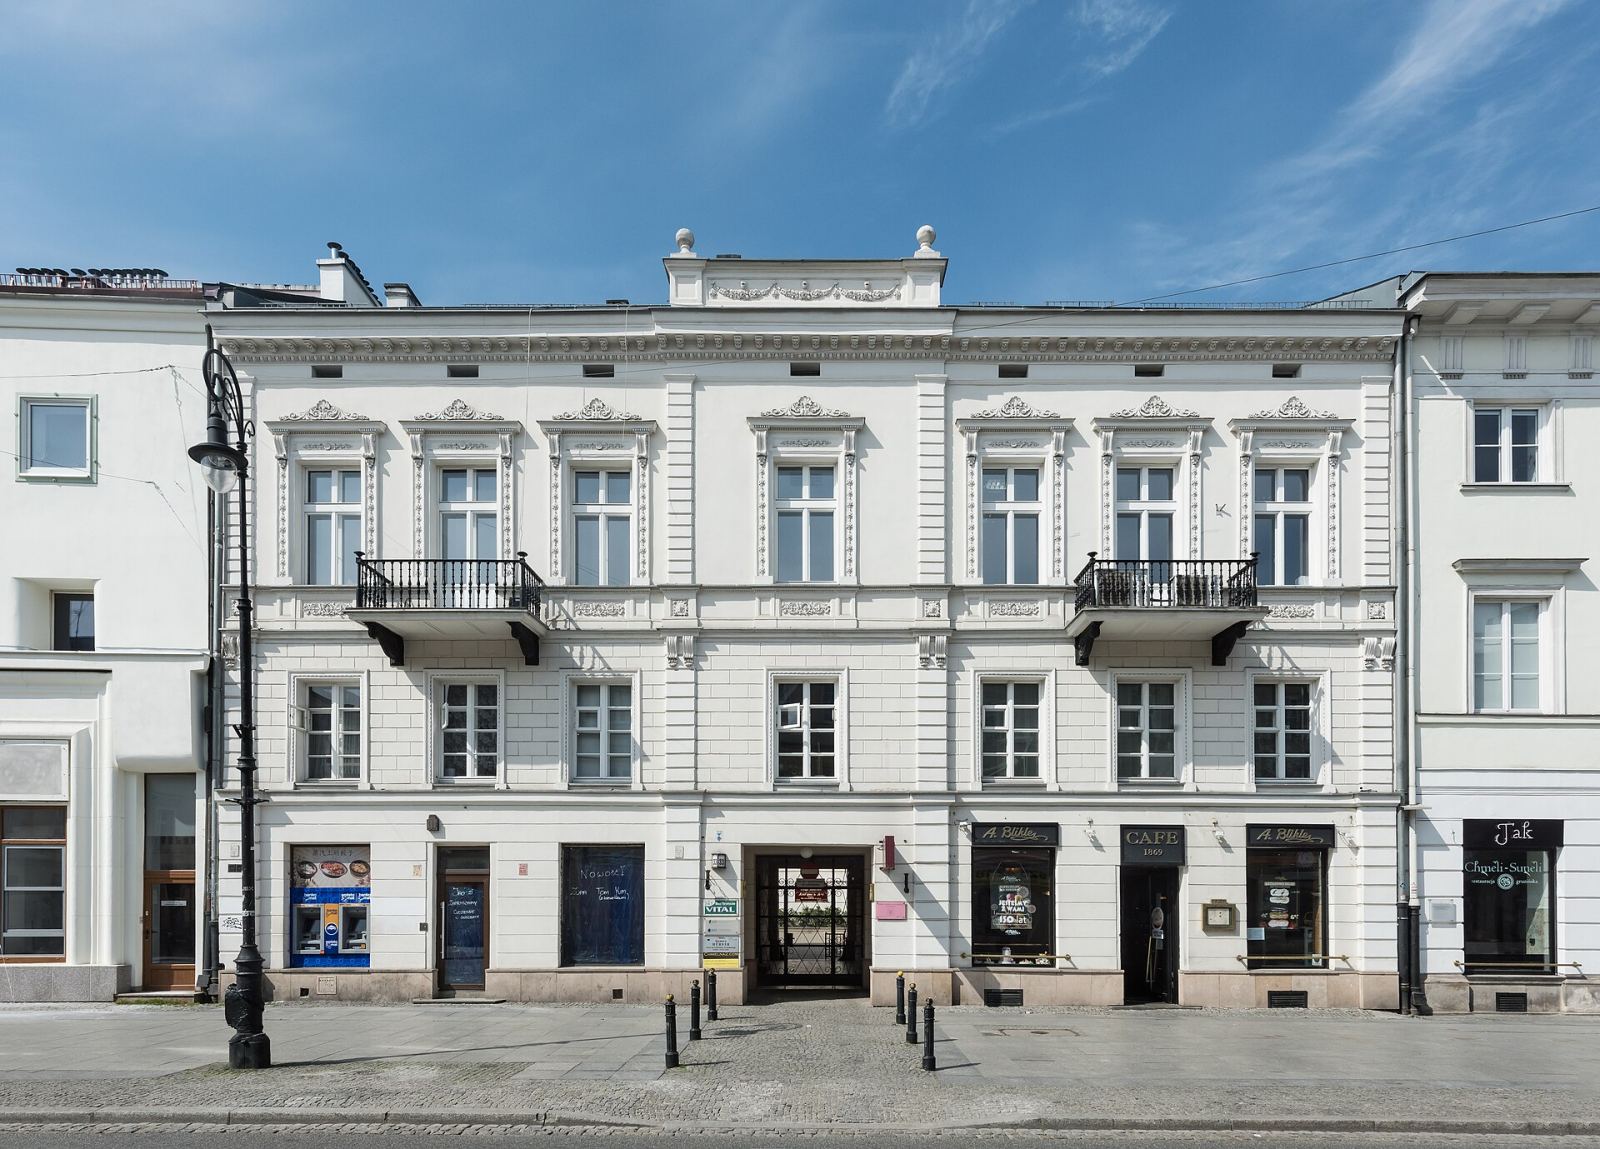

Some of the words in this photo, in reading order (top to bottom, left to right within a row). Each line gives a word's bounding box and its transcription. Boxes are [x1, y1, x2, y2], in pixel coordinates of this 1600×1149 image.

[1001, 826, 1048, 841] Blikle
[1126, 831, 1179, 845] CAFE
[1275, 828, 1323, 843] Blikle
[1143, 848, 1163, 856] 1869
[1000, 915, 1014, 923] 150
